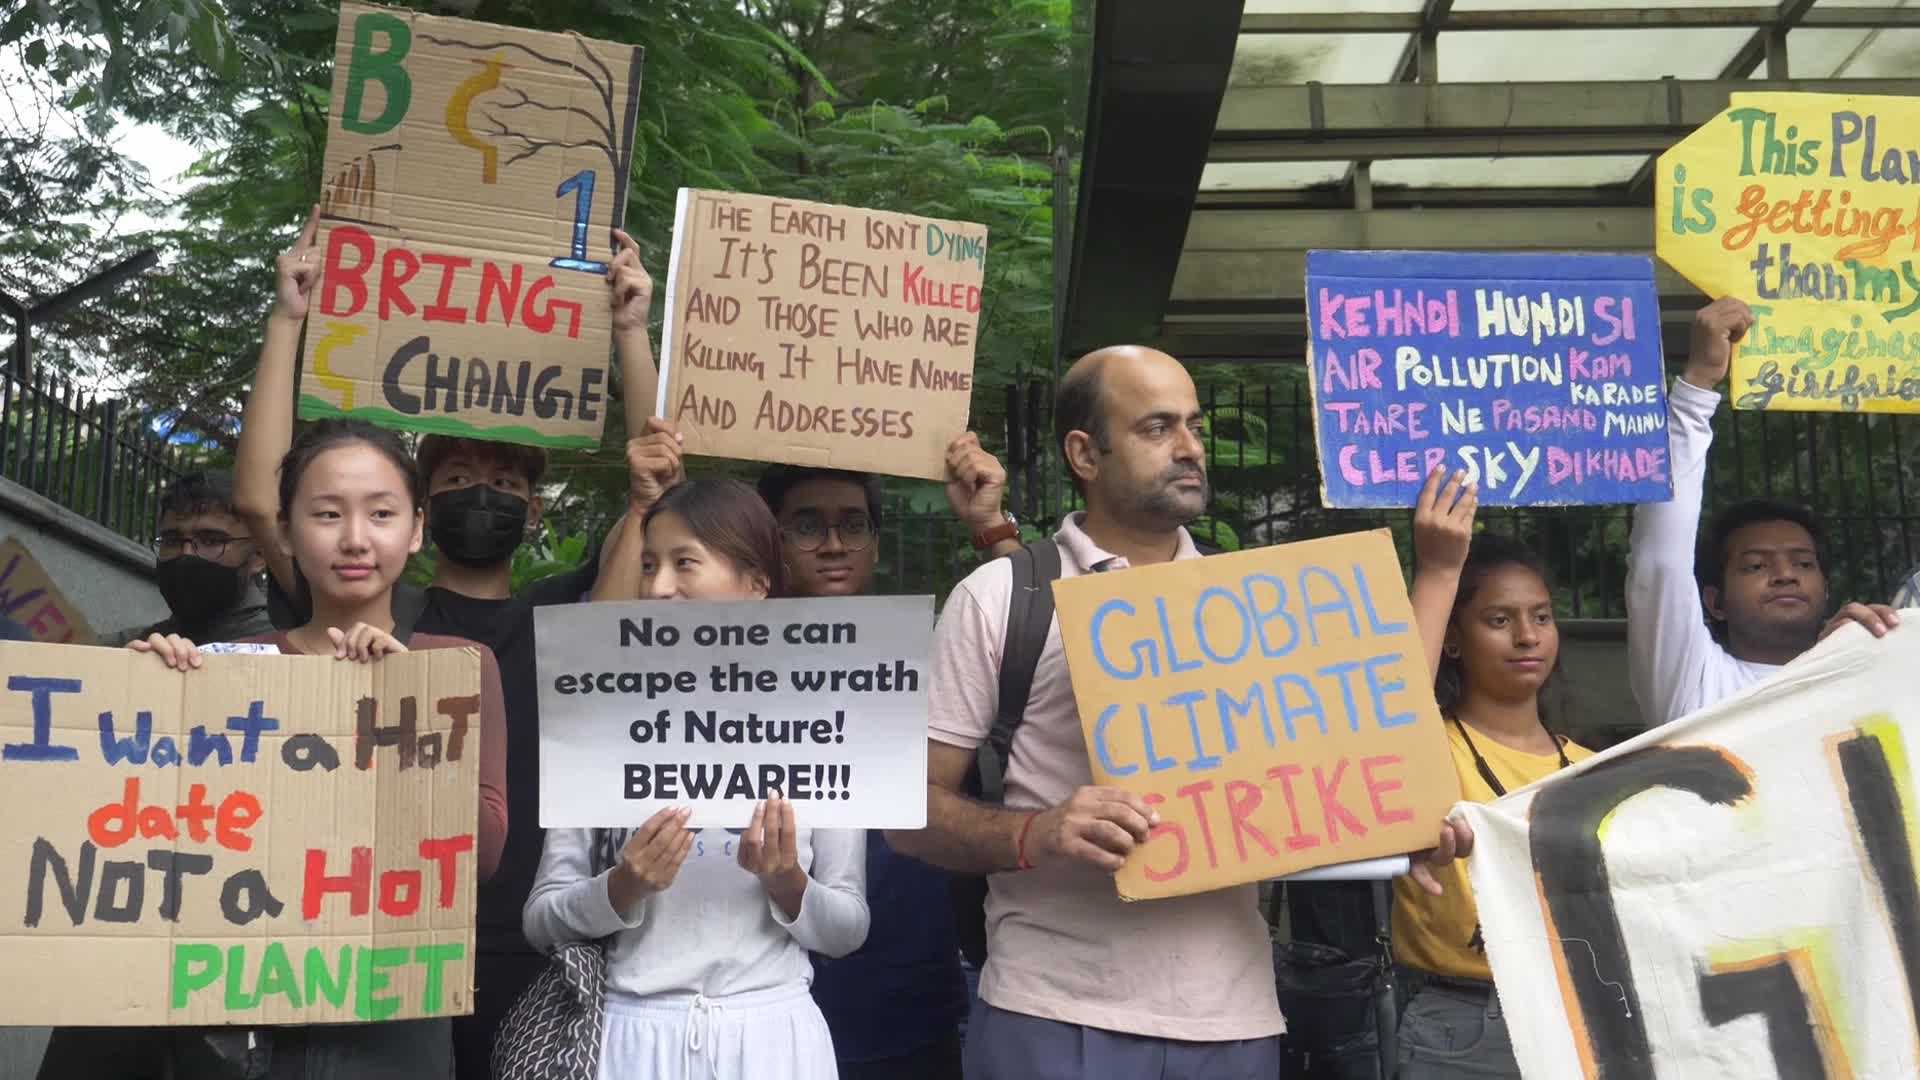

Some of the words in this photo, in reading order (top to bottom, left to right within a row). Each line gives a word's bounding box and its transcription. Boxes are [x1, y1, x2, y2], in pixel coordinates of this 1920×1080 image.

[341, 13, 412, 135] B
[1727, 107, 1822, 177] This
[549, 170, 609, 275] 1
[1672, 163, 1717, 235] is
[698, 195, 752, 232] THE
[770, 202, 846, 242] EARTH
[865, 216, 921, 250] ISN'T
[926, 223, 985, 270] DYING
[319, 226, 583, 339] BRING
[799, 243, 888, 299] BEEN
[903, 261, 982, 313] KILLED
[1751, 243, 1847, 300] than
[685, 288, 740, 325] AND
[758, 296, 839, 338] THOSE
[854, 309, 913, 341] WHO
[922, 314, 972, 346] ARE
[1319, 287, 1460, 340] KEHNDI
[1475, 288, 1585, 345] HUNDI
[1591, 297, 1636, 347] SI
[382, 336, 604, 421] CHANGE
[683, 333, 764, 380] KILLING
[837, 347, 903, 386] HAVE
[909, 358, 973, 391] NAME
[1323, 348, 1383, 394] AIR
[1395, 345, 1563, 391] POLLUTION
[1568, 347, 1632, 381] KAM
[1570, 382, 1658, 406] KARADE
[678, 384, 737, 429] AND
[754, 390, 914, 438] ADDRESSES
[1324, 402, 1430, 440] TAARE
[1440, 400, 1485, 434] NE
[1492, 400, 1597, 433] PASAND
[1603, 412, 1665, 438] MAINU
[1456, 441, 1540, 499] SKY
[1546, 446, 1666, 486] DIKHADE
[619, 617, 680, 647] No
[693, 622, 770, 647] one
[782, 620, 857, 645] can
[1089, 562, 1409, 680] GLOBAL
[553, 669, 697, 699] escape
[710, 662, 778, 693] the
[791, 660, 920, 692] wrath
[1, 676, 82, 761] I
[281, 733, 341, 772] a
[629, 709, 671, 743] of
[684, 710, 845, 744] Nature!
[1094, 652, 1418, 778] CLIMATE
[86, 776, 263, 852] date
[623, 764, 851, 800] BEWARE!!!
[1143, 754, 1414, 883] STRIKE
[219, 868, 284, 925] a
[170, 941, 464, 1021] PLANET
